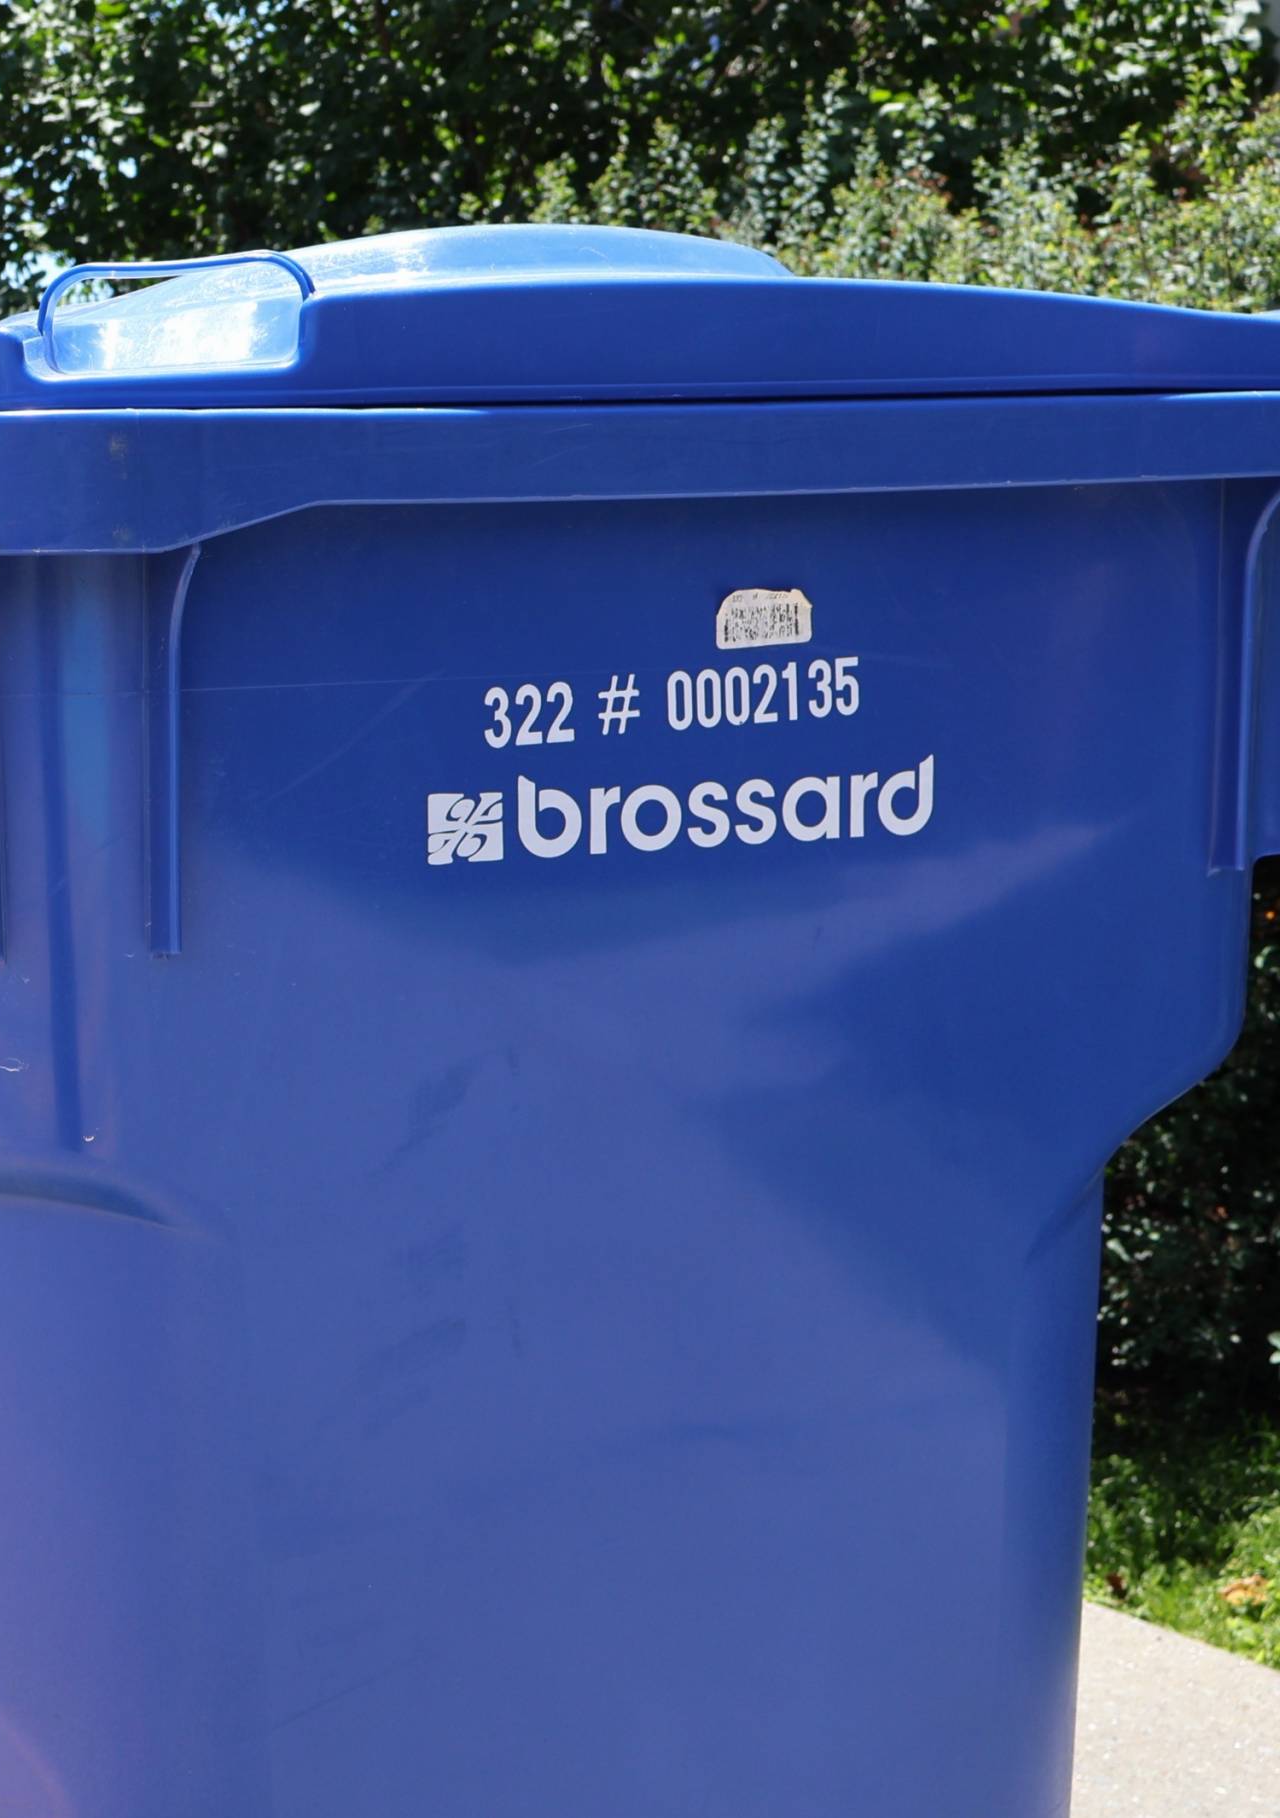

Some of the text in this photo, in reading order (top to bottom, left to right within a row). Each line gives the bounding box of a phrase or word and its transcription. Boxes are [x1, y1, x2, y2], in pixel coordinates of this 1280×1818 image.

[484, 656, 860, 748] 322 # 0002135
[518, 754, 934, 858] brossard
